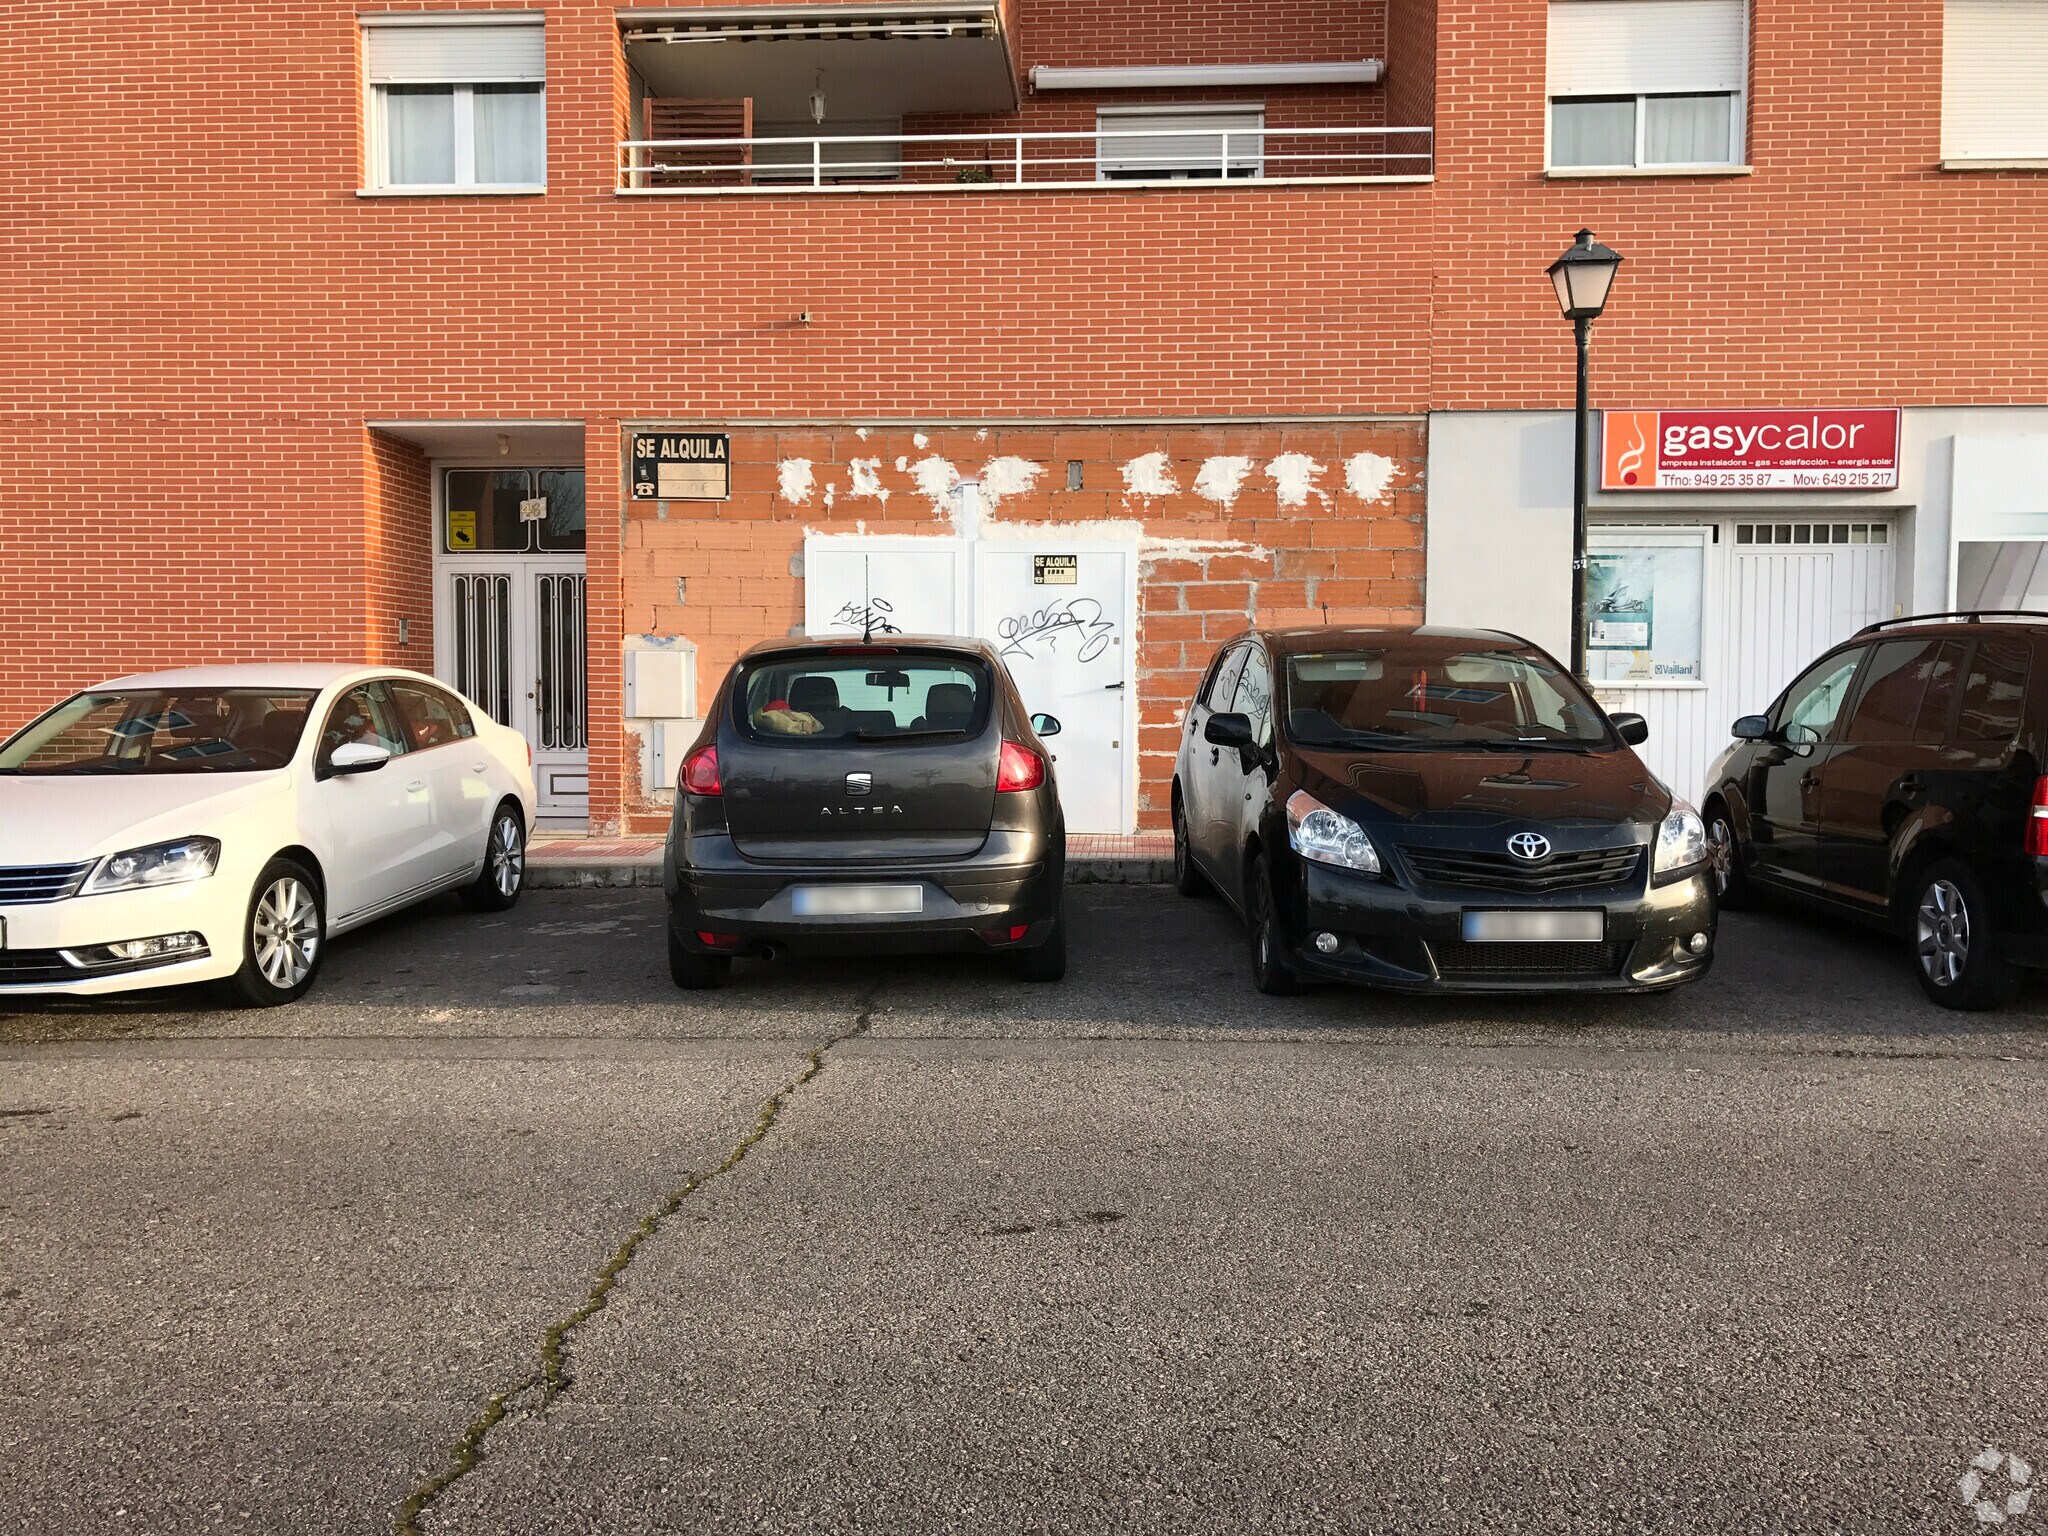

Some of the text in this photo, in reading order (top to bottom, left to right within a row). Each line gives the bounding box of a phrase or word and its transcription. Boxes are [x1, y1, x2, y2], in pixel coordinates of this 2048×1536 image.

[1663, 415, 1865, 456] gasycalor
[636, 438, 726, 460] SE ALQUILA
[1661, 459, 1698, 468] empresa
[1699, 458, 1747, 467] instaladora
[1755, 459, 1771, 468] gas
[1779, 458, 1829, 466] calefacción
[1837, 458, 1870, 467] energía
[1871, 457, 1893, 466] solar
[1662, 474, 1692, 486] Tfno:
[1694, 473, 1718, 486] 949
[1720, 473, 1735, 486] 25
[1738, 473, 1754, 486] 35
[1756, 473, 1772, 486] 87
[1793, 473, 1820, 486] Mov:
[1822, 473, 1847, 486] 649
[1849, 472, 1869, 485] 215
[1872, 472, 1892, 485] 217
[1035, 556, 1076, 567] SE ALQUILA
[1662, 664, 1694, 675] Vaillant
[820, 805, 903, 815] ALTEA
